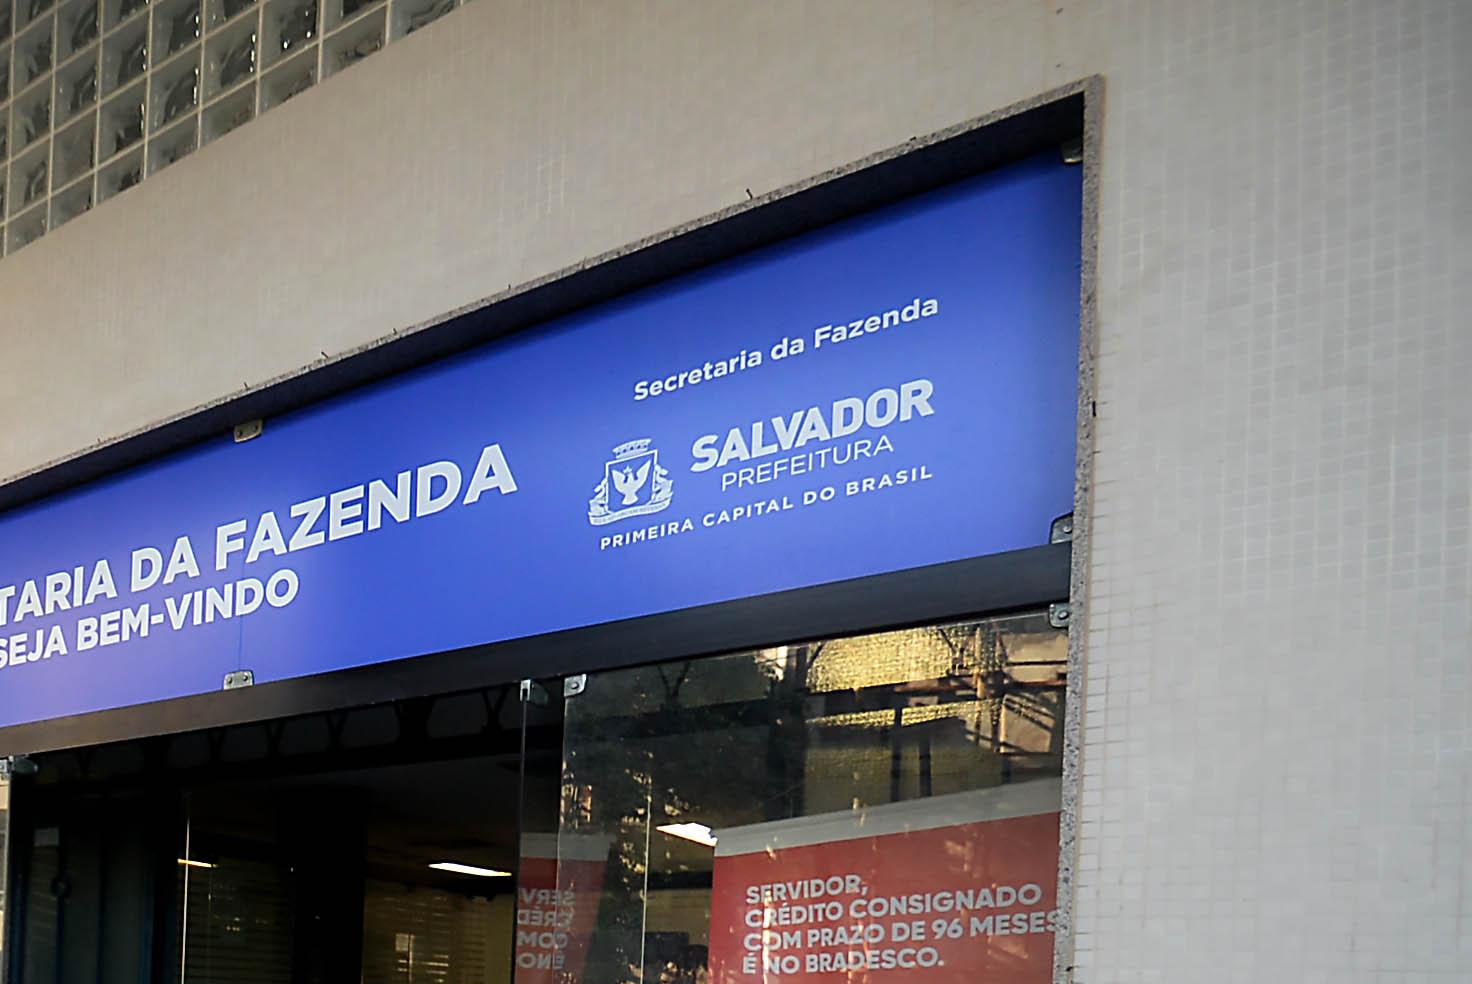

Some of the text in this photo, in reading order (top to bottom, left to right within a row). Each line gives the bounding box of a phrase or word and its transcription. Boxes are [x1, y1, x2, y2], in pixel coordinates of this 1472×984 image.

[633, 297, 939, 401] Secretaria da Fazenda
[690, 378, 934, 472] SALVADOR
[721, 434, 894, 492] PREFEITURA
[130, 536, 200, 593] DA
[215, 443, 519, 571] FAZENDA
[600, 518, 694, 550] PRIMEIRA
[702, 496, 794, 528] CAPITAL
[803, 486, 835, 505] DO
[846, 465, 933, 496] BRASIL
[76, 568, 299, 650] BEM-VINDO
[745, 883, 1042, 928] CRÉDITO CONSIGNADO
[746, 873, 868, 905] SERVIDOR,
[742, 946, 945, 975] É NO BRADESCO.
[743, 930, 802, 951] COM
[807, 922, 884, 948] PRAZO
[891, 920, 926, 942] DE
[931, 917, 963, 939] 96
